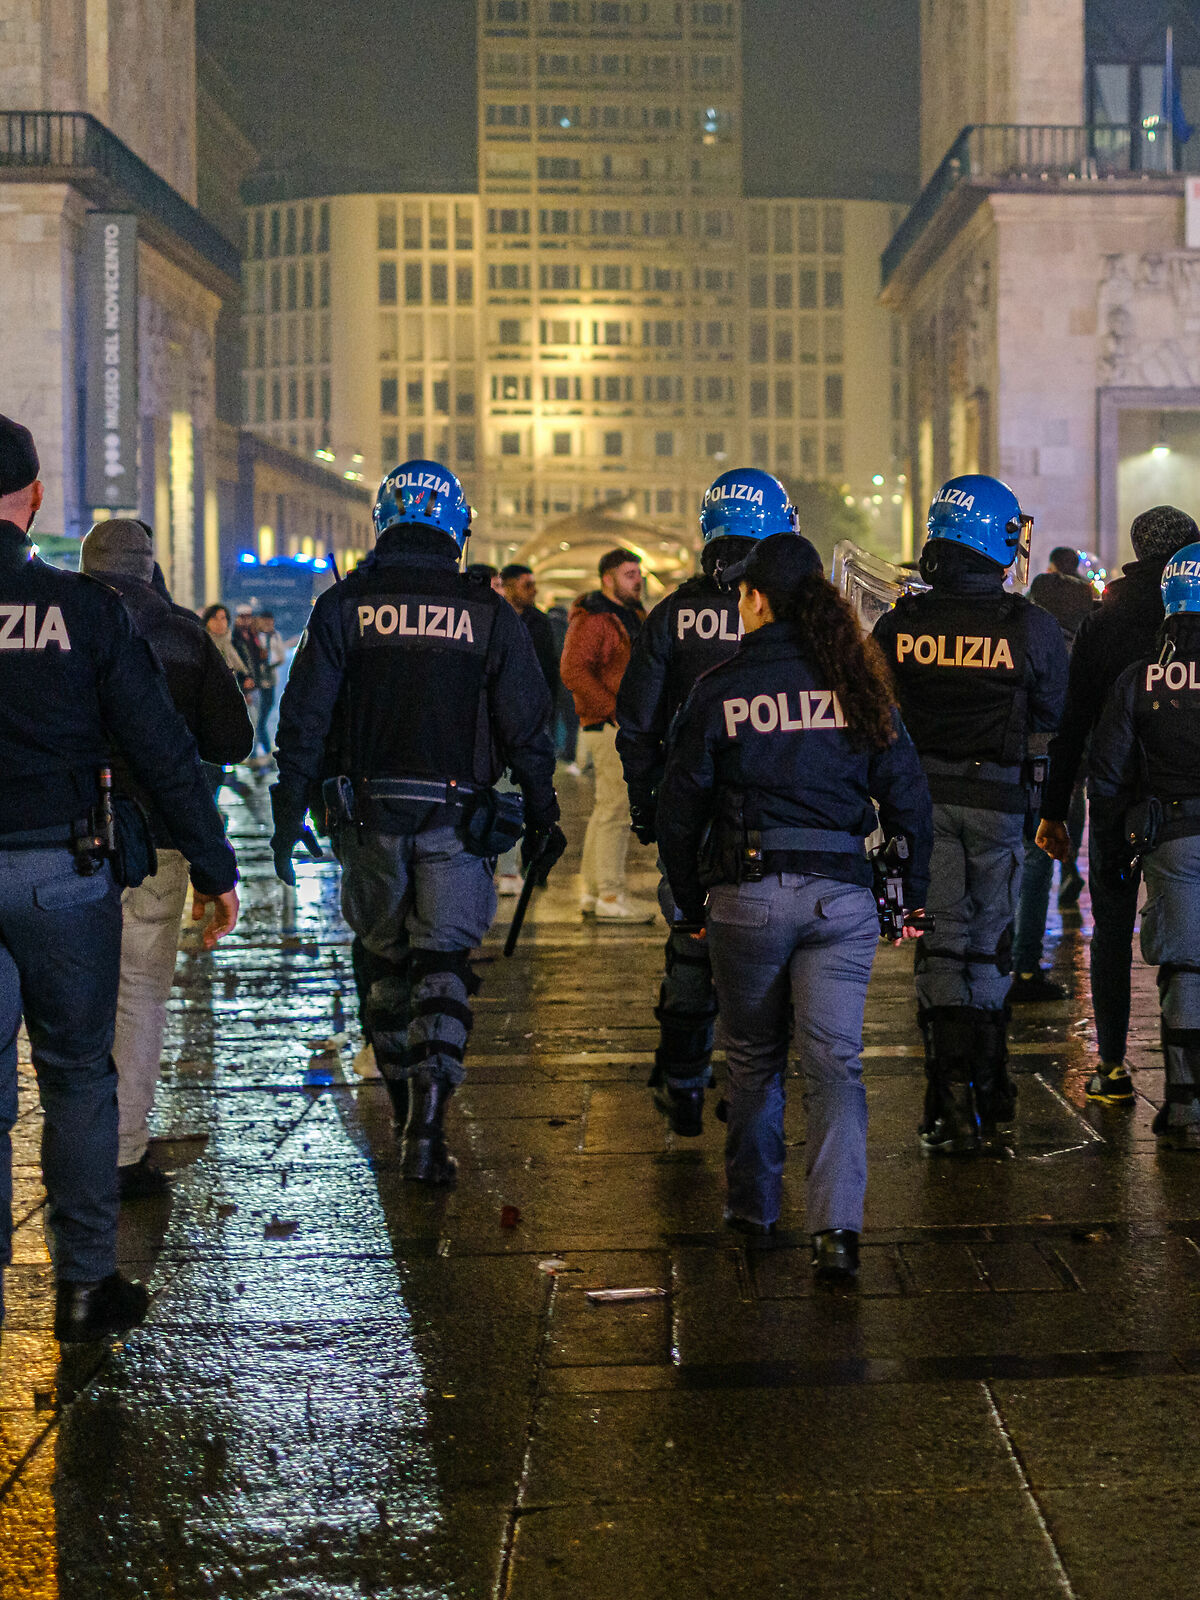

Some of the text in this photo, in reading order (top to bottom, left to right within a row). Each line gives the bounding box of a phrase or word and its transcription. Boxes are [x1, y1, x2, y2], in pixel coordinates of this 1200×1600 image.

[104, 224, 120, 330] NOVECENTO
[104, 332, 120, 366] DEL
[104, 367, 120, 430] MUSEO
[386, 472, 451, 498] POLIZIA
[705, 484, 764, 507] POLIZIA
[0, 604, 71, 651] ZIA
[358, 605, 475, 642] POLIZIA
[897, 632, 1014, 670] POLIZIA
[723, 690, 848, 737] POLIZI
